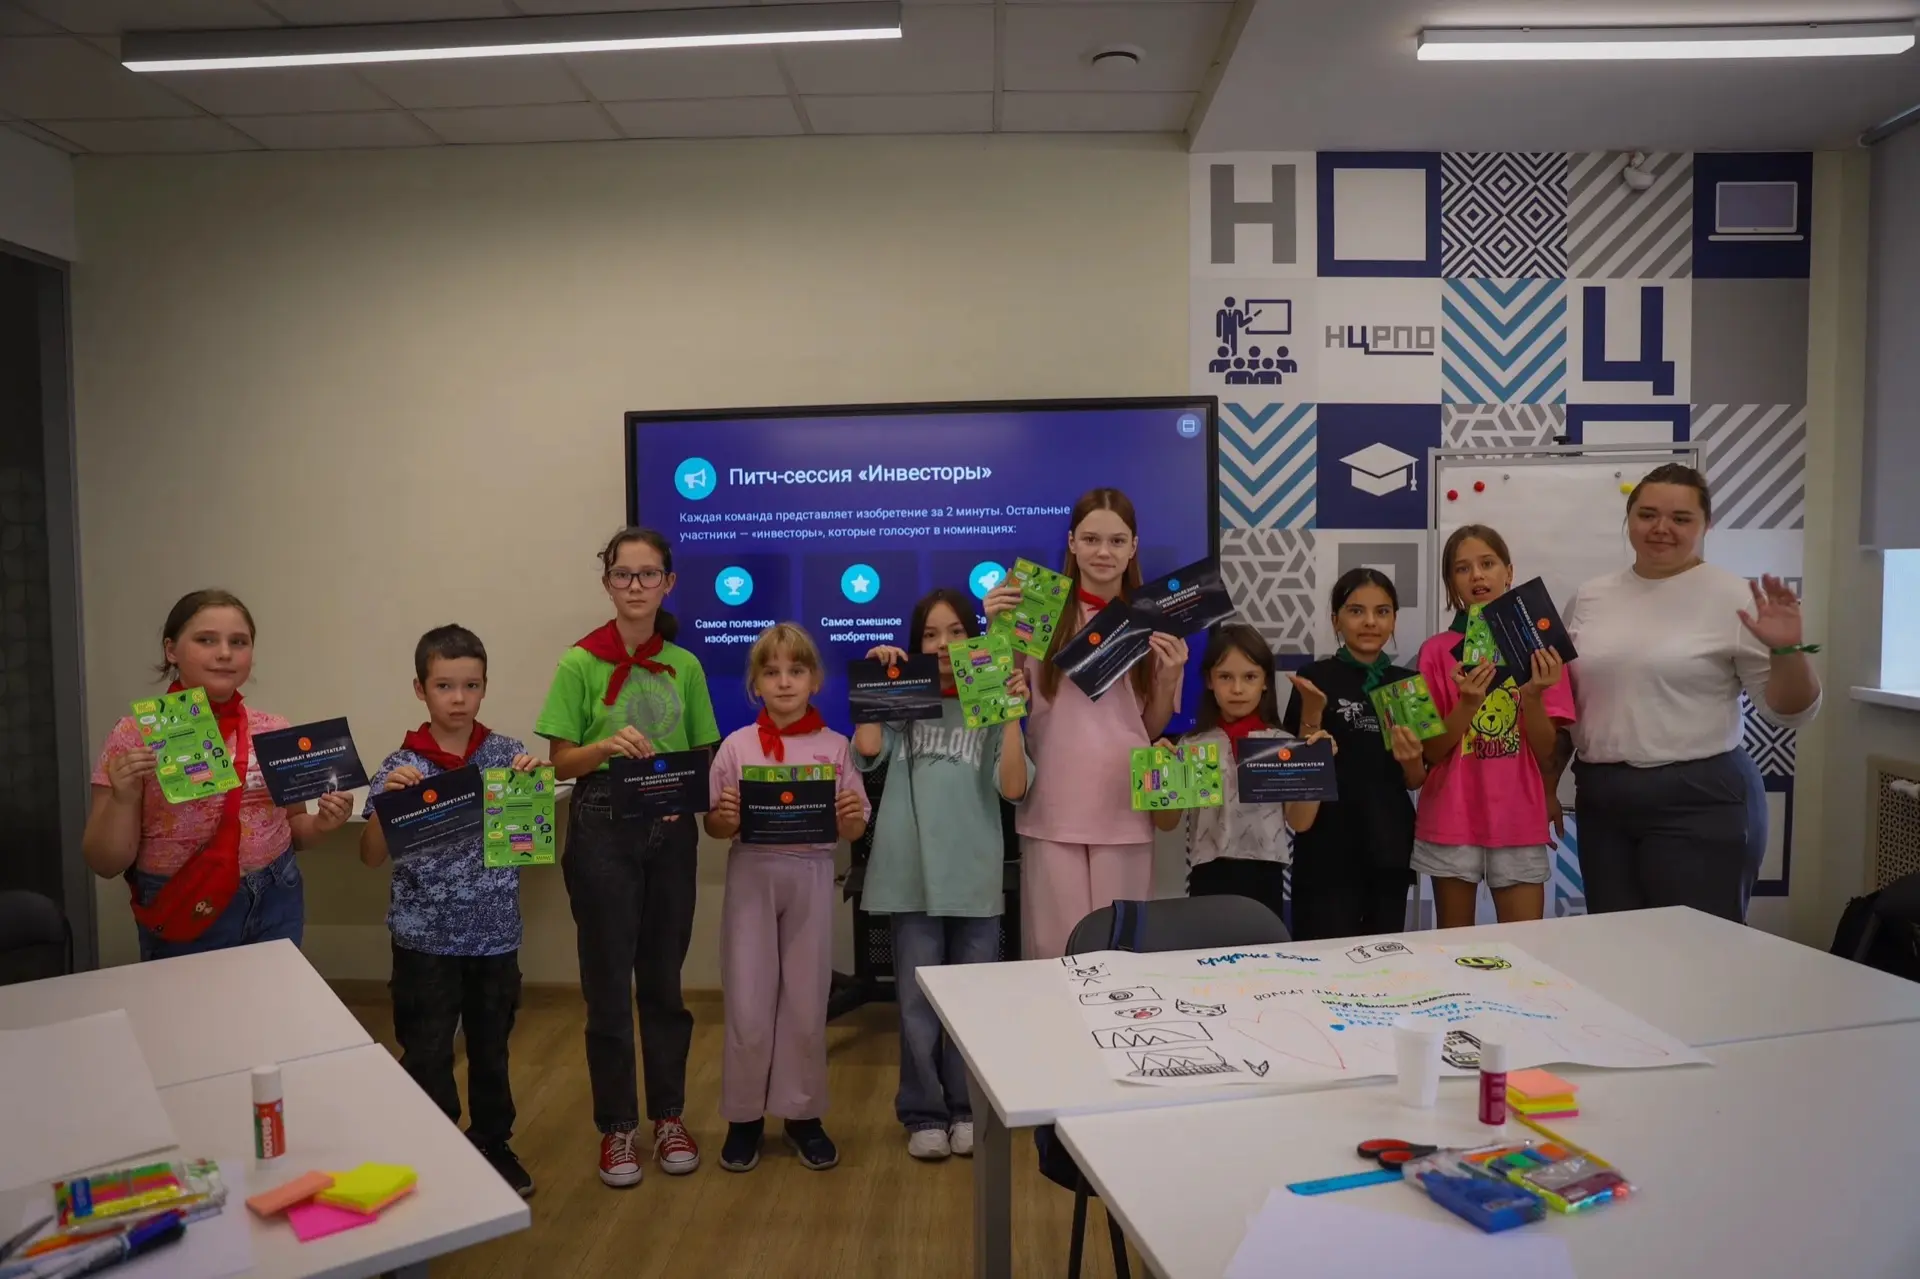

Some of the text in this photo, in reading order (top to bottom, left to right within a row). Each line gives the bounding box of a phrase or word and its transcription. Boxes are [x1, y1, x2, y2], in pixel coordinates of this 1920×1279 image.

[1210, 164, 1296, 264] Н
[1325, 325, 1435, 356] НЦРПО
[1582, 286, 1676, 396] Ц
[729, 464, 992, 486] Питч-сессия «Инвесторы»
[680, 504, 1070, 524] Каждая команда представляет изобретение за 2 минуты. Остальные
[680, 530, 736, 543] участники
[752, 528, 826, 540] «инвесторы»,
[828, 527, 876, 539] которые
[879, 526, 930, 538] голосуют
[934, 527, 940, 535] в
[943, 524, 1017, 536] номинациях:
[695, 618, 776, 629] Самое полезное
[820, 616, 902, 627] Самое смешное
[704, 634, 760, 644] изобретен
[830, 631, 894, 642] изобретение
[1532, 625, 1544, 648] ИЗОБРЕТ
[269, 746, 346, 767] СЕРТИФИКАТ ИЗОБРЕТАТЕЛЯ
[390, 792, 476, 824] СЕРТИФИКАТ ИЗОБРЕТАТЕЛЯ
